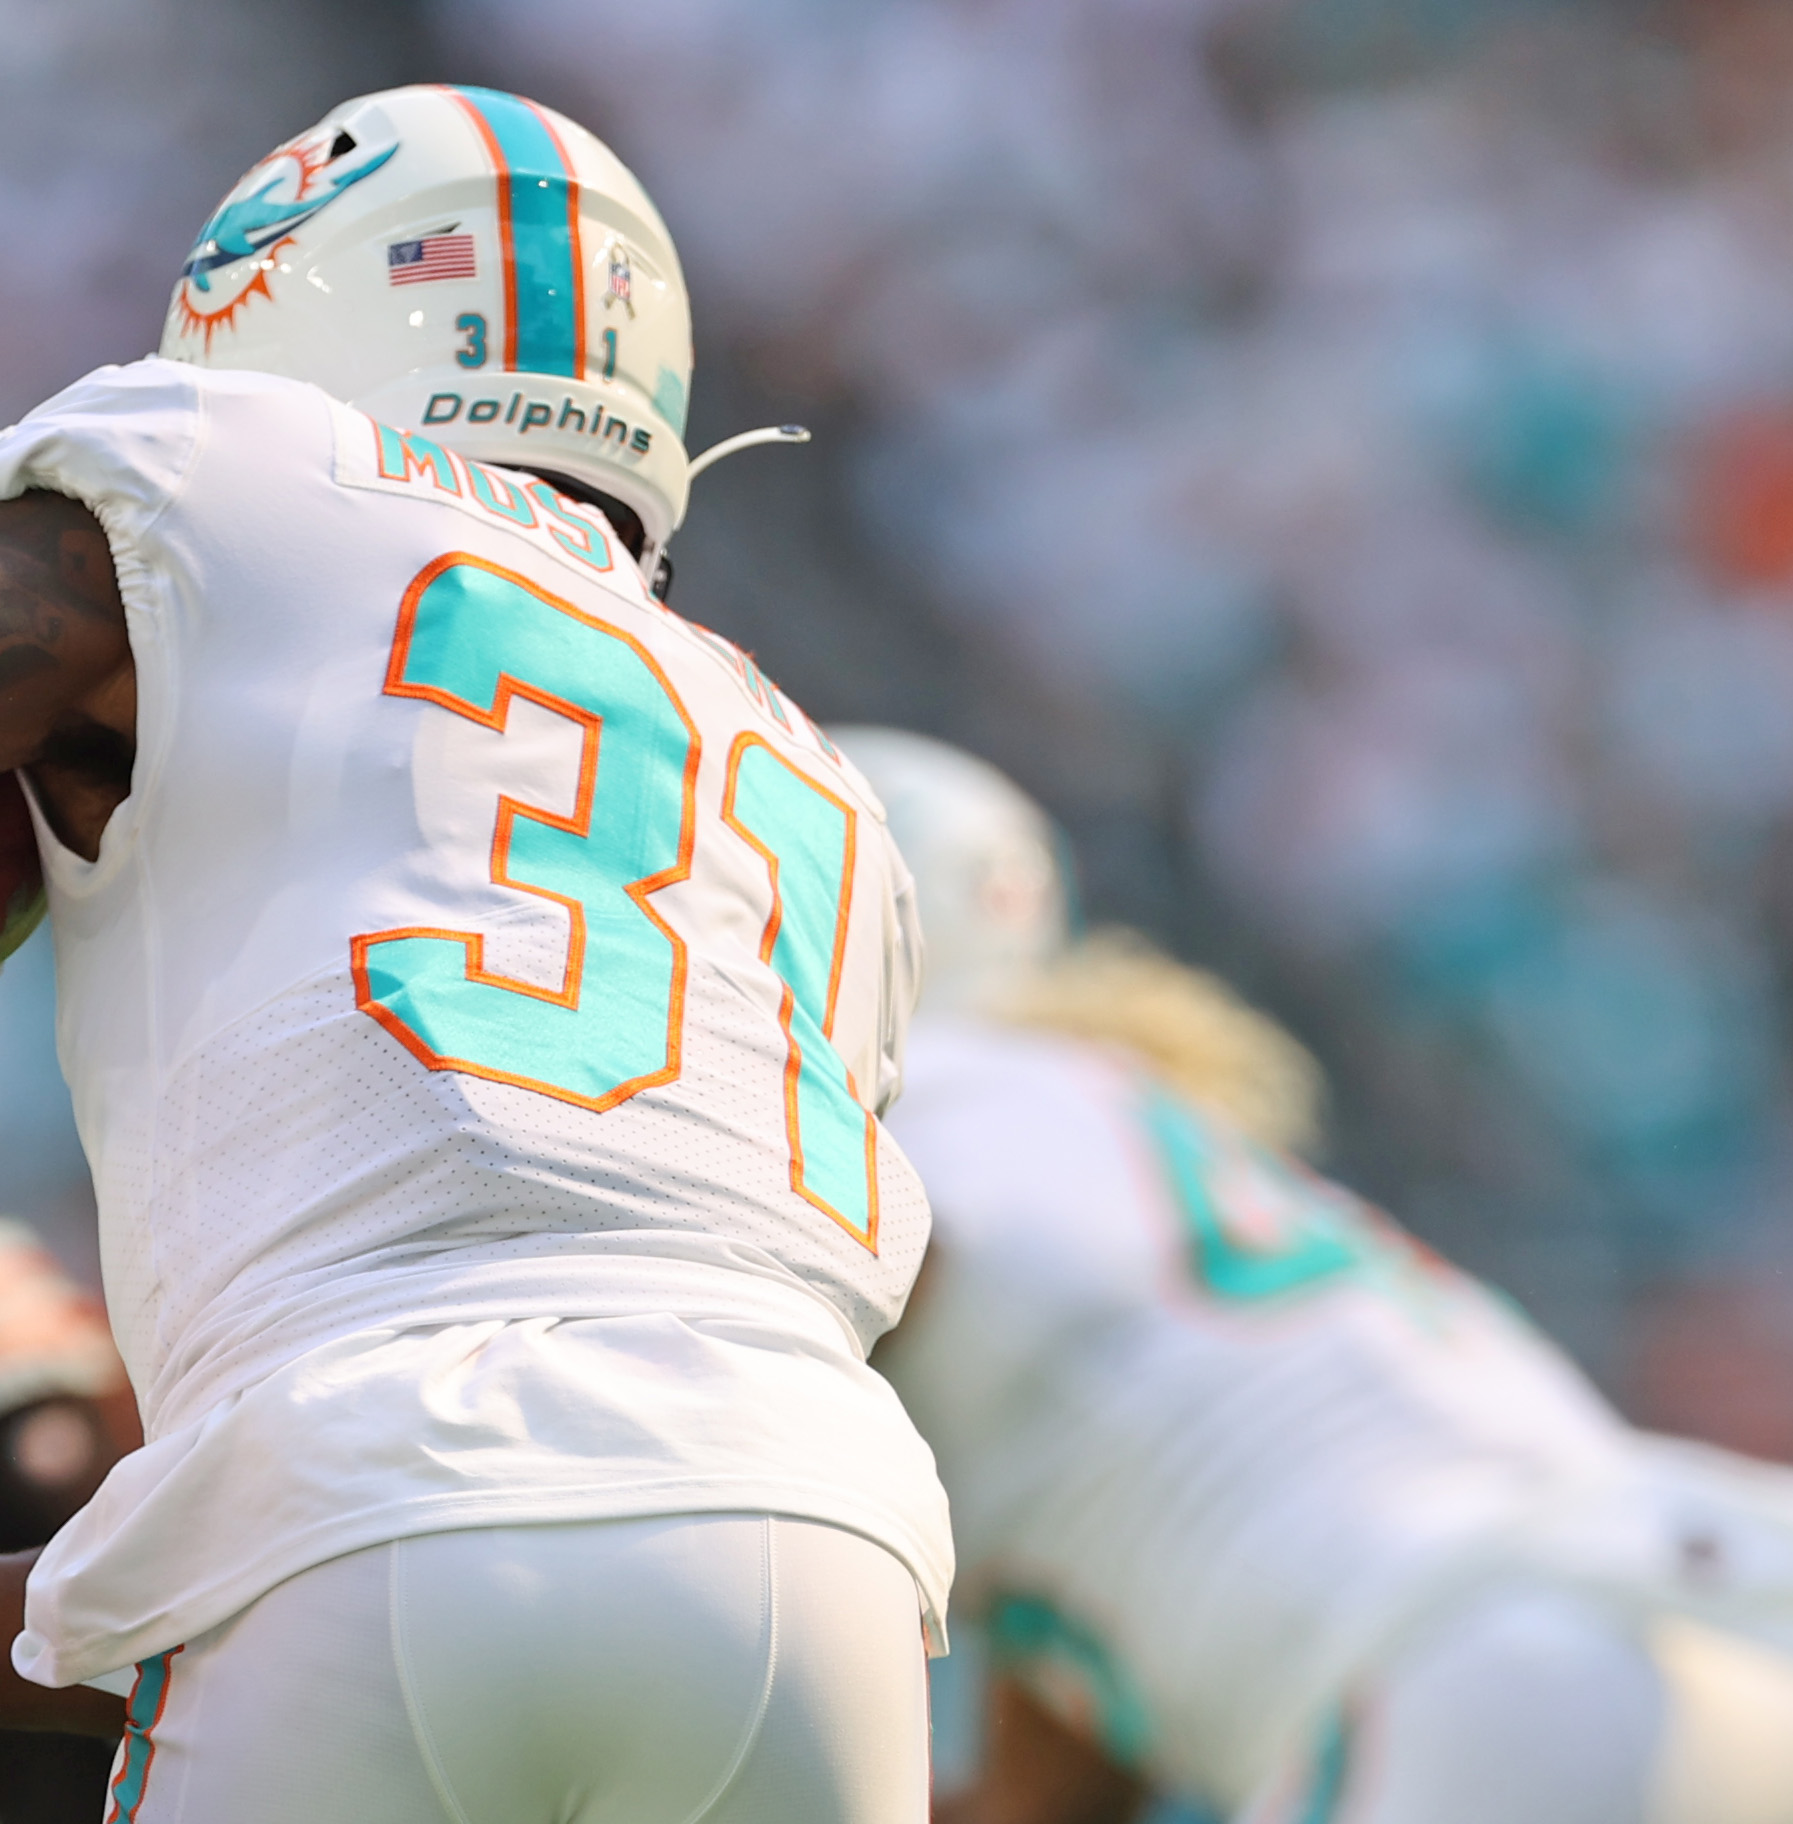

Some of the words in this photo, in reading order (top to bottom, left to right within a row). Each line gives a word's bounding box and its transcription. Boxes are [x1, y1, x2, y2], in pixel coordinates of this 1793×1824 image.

[455, 313, 487, 369] 3
[602, 326, 618, 383] 1
[420, 391, 653, 454] Dolphins
[350, 551, 879, 1256] 31
